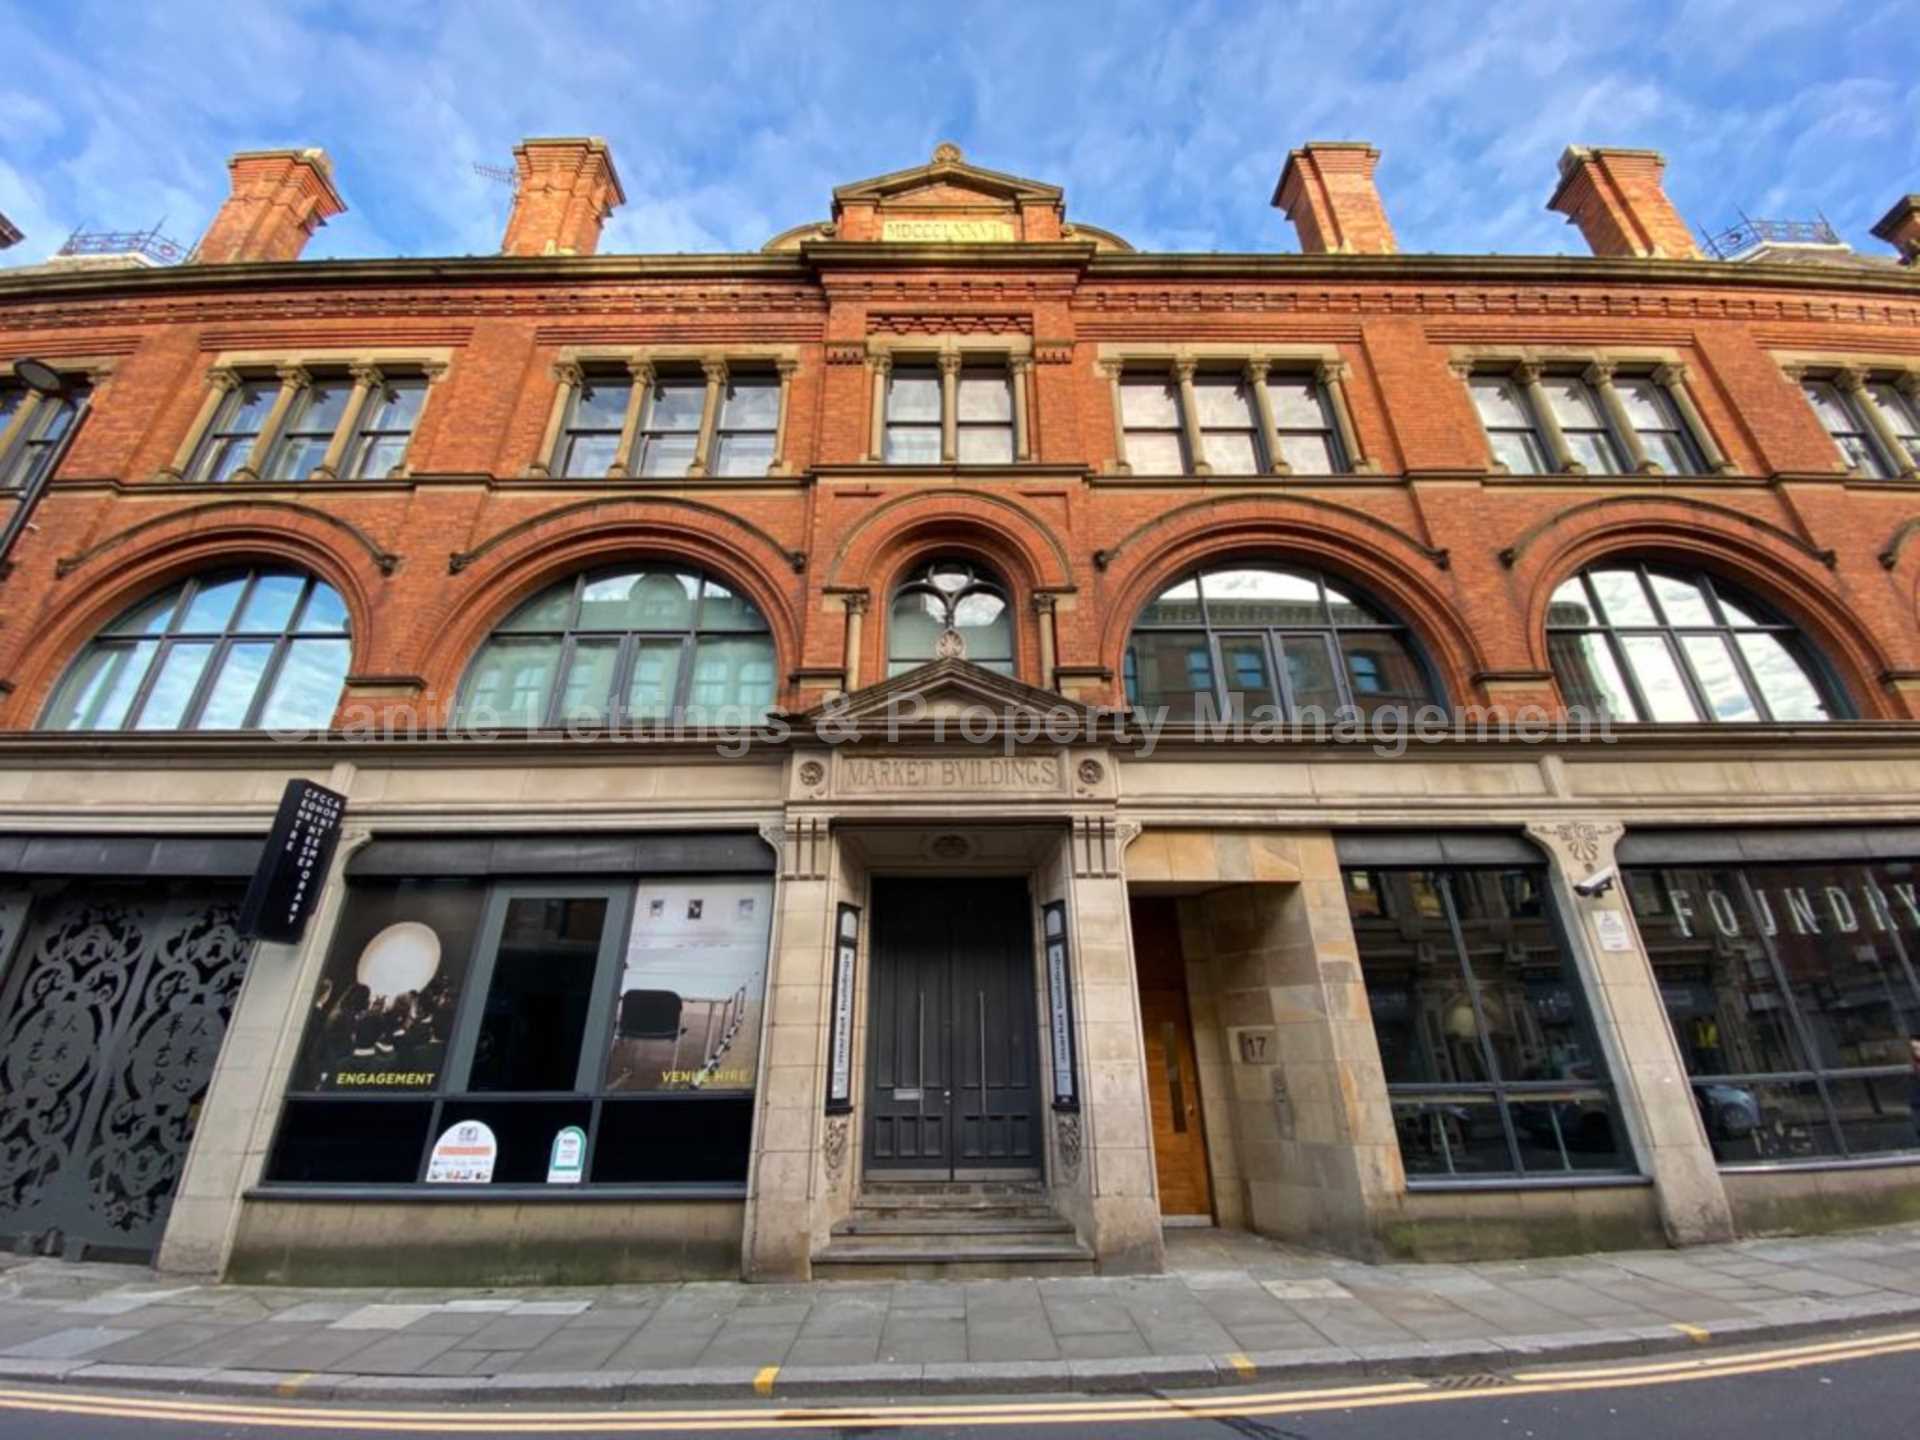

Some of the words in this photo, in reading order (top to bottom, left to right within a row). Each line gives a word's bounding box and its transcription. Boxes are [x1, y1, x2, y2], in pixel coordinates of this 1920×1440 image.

[848, 760, 934, 786] MARKET
[1247, 1036, 1267, 1057] 17
[336, 1072, 435, 1085] ENGAGEMENT
